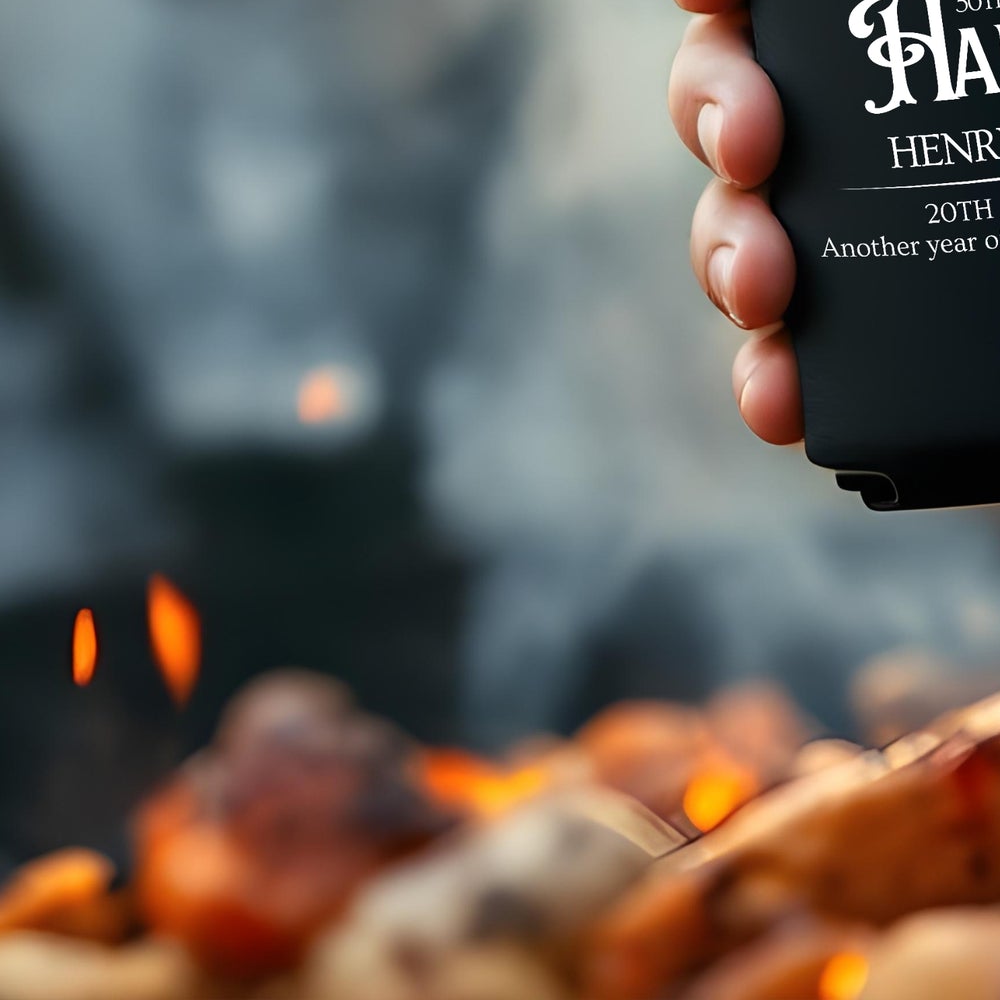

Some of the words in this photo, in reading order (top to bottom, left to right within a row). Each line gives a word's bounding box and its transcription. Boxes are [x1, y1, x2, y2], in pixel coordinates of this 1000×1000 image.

[925, 199, 994, 224] 20TH
[822, 236, 920, 257] Another
[926, 237, 977, 261] year
